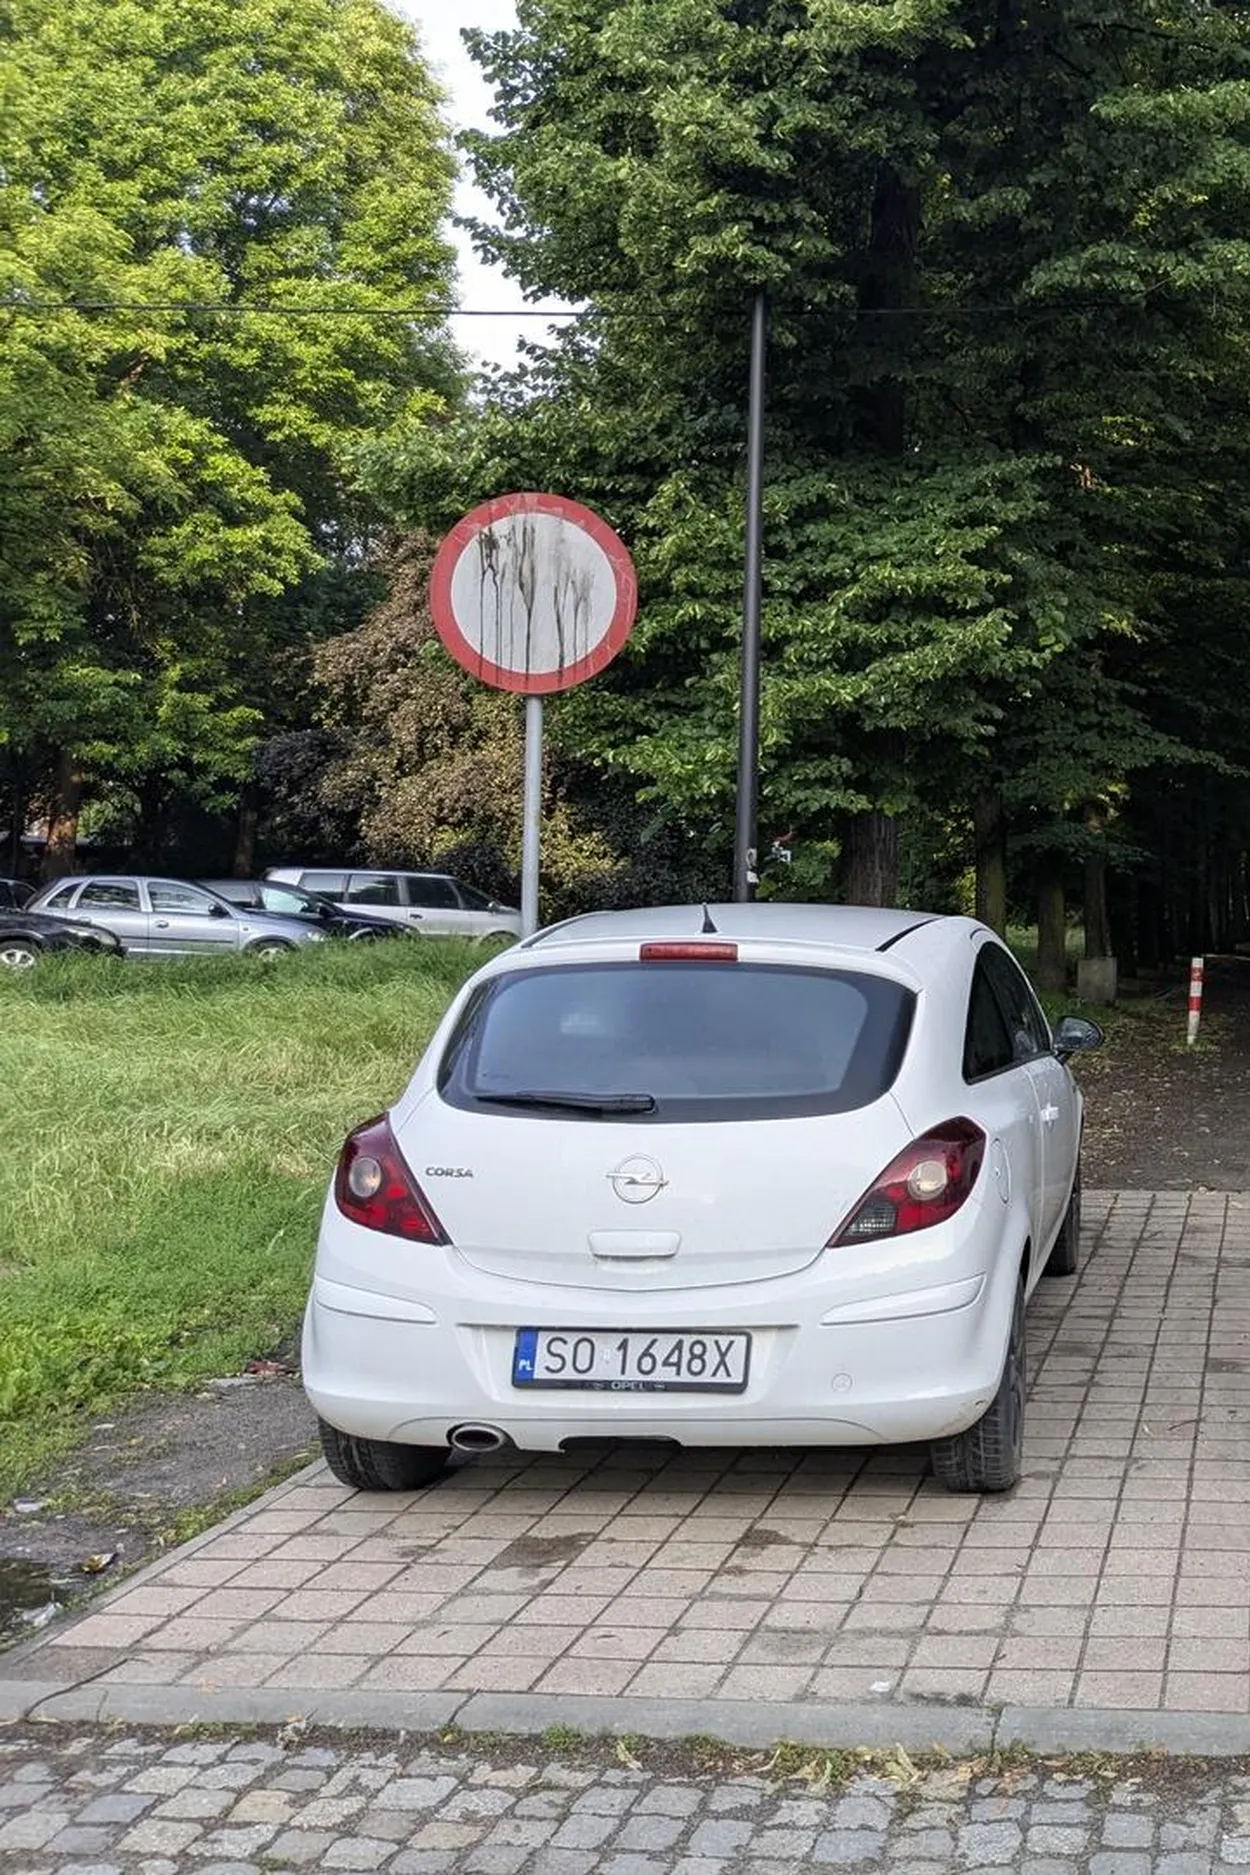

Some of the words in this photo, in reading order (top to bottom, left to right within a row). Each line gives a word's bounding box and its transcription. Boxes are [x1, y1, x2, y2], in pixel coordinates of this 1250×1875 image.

[425, 1166, 474, 1178] CORSA
[545, 1336, 596, 1374] SO
[617, 1337, 735, 1378] 1648X
[518, 1359, 533, 1371] PL
